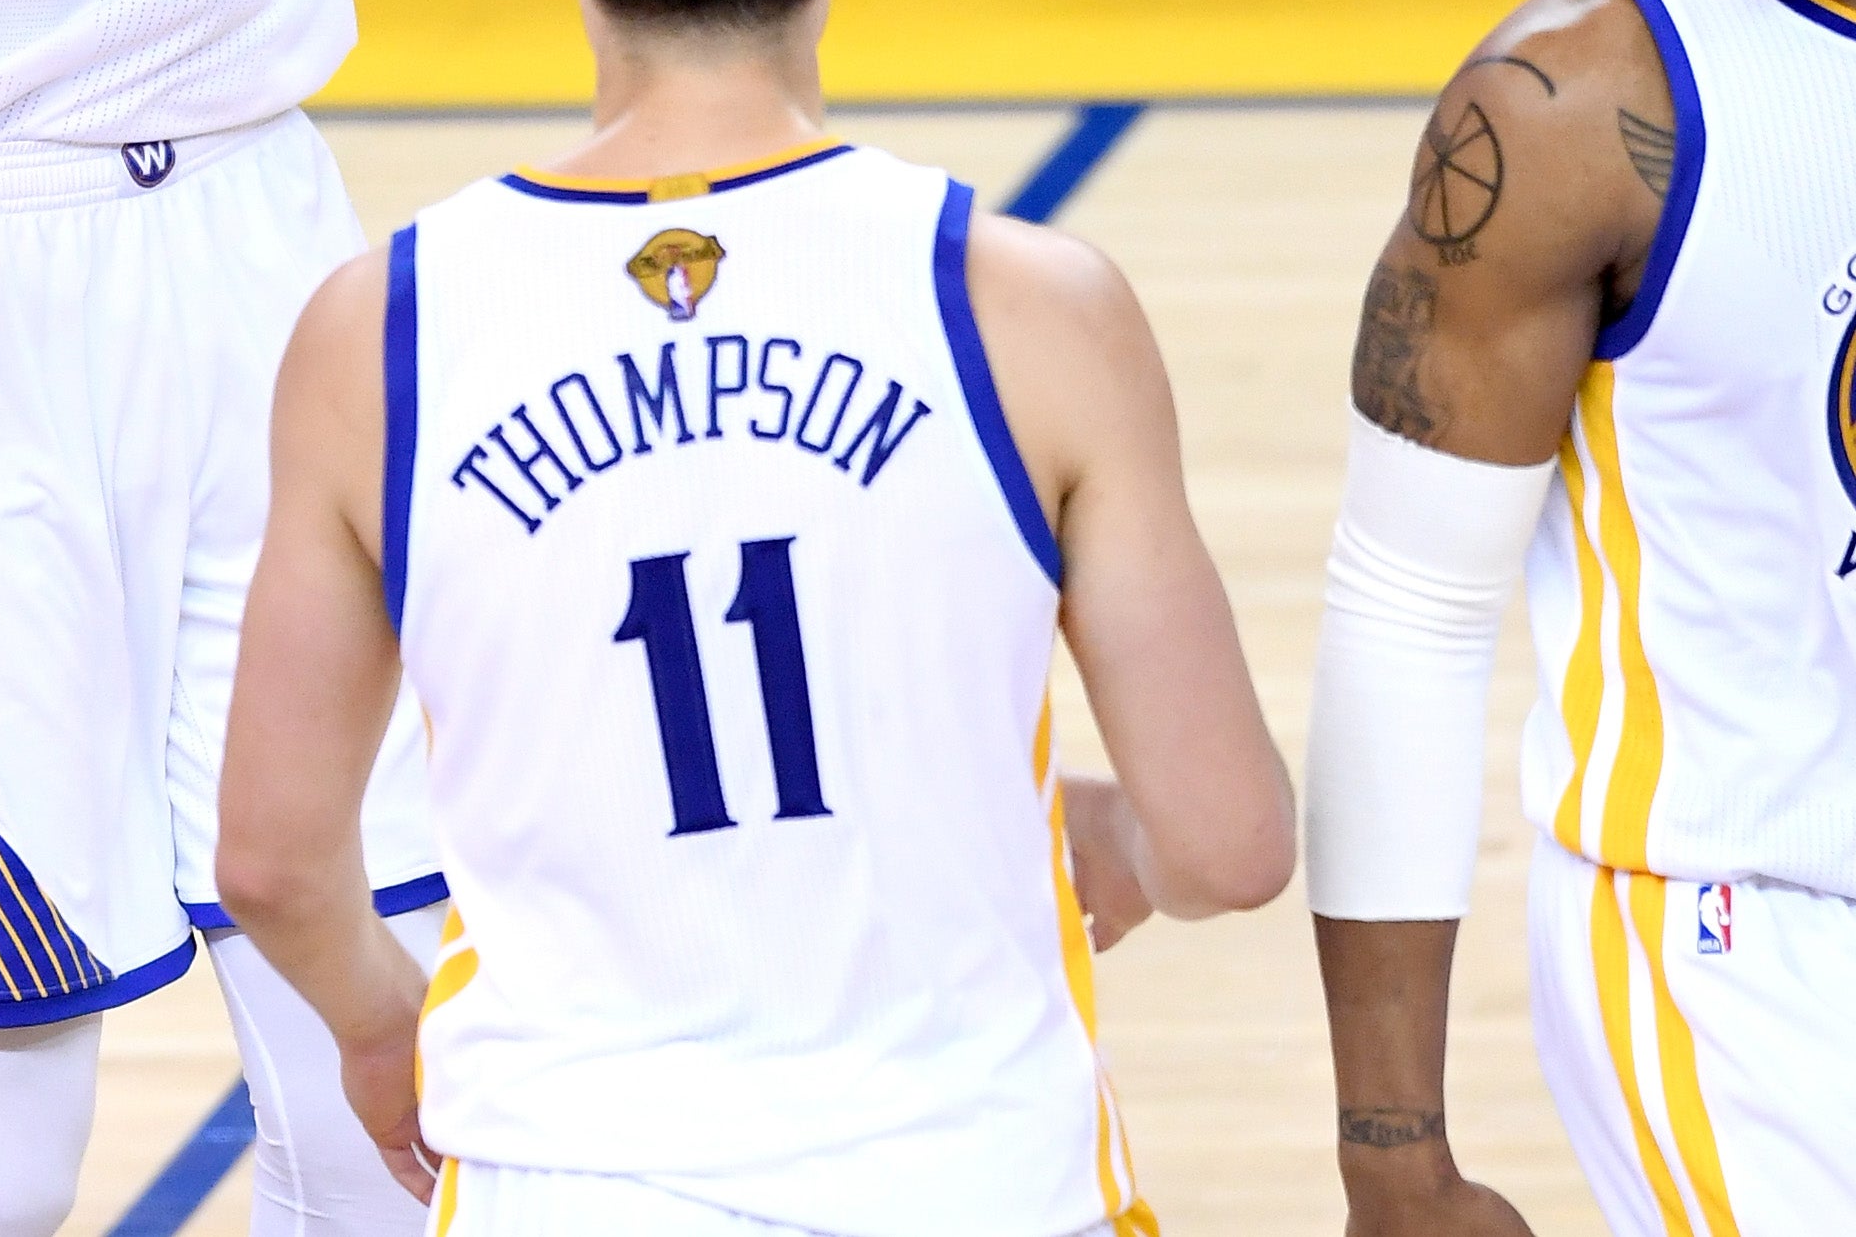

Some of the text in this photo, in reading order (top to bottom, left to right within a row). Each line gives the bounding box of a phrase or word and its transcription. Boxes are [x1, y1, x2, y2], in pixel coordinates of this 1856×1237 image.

[127, 140, 165, 175] W
[451, 335, 932, 534] THOMPSON
[613, 536, 834, 838] 11
